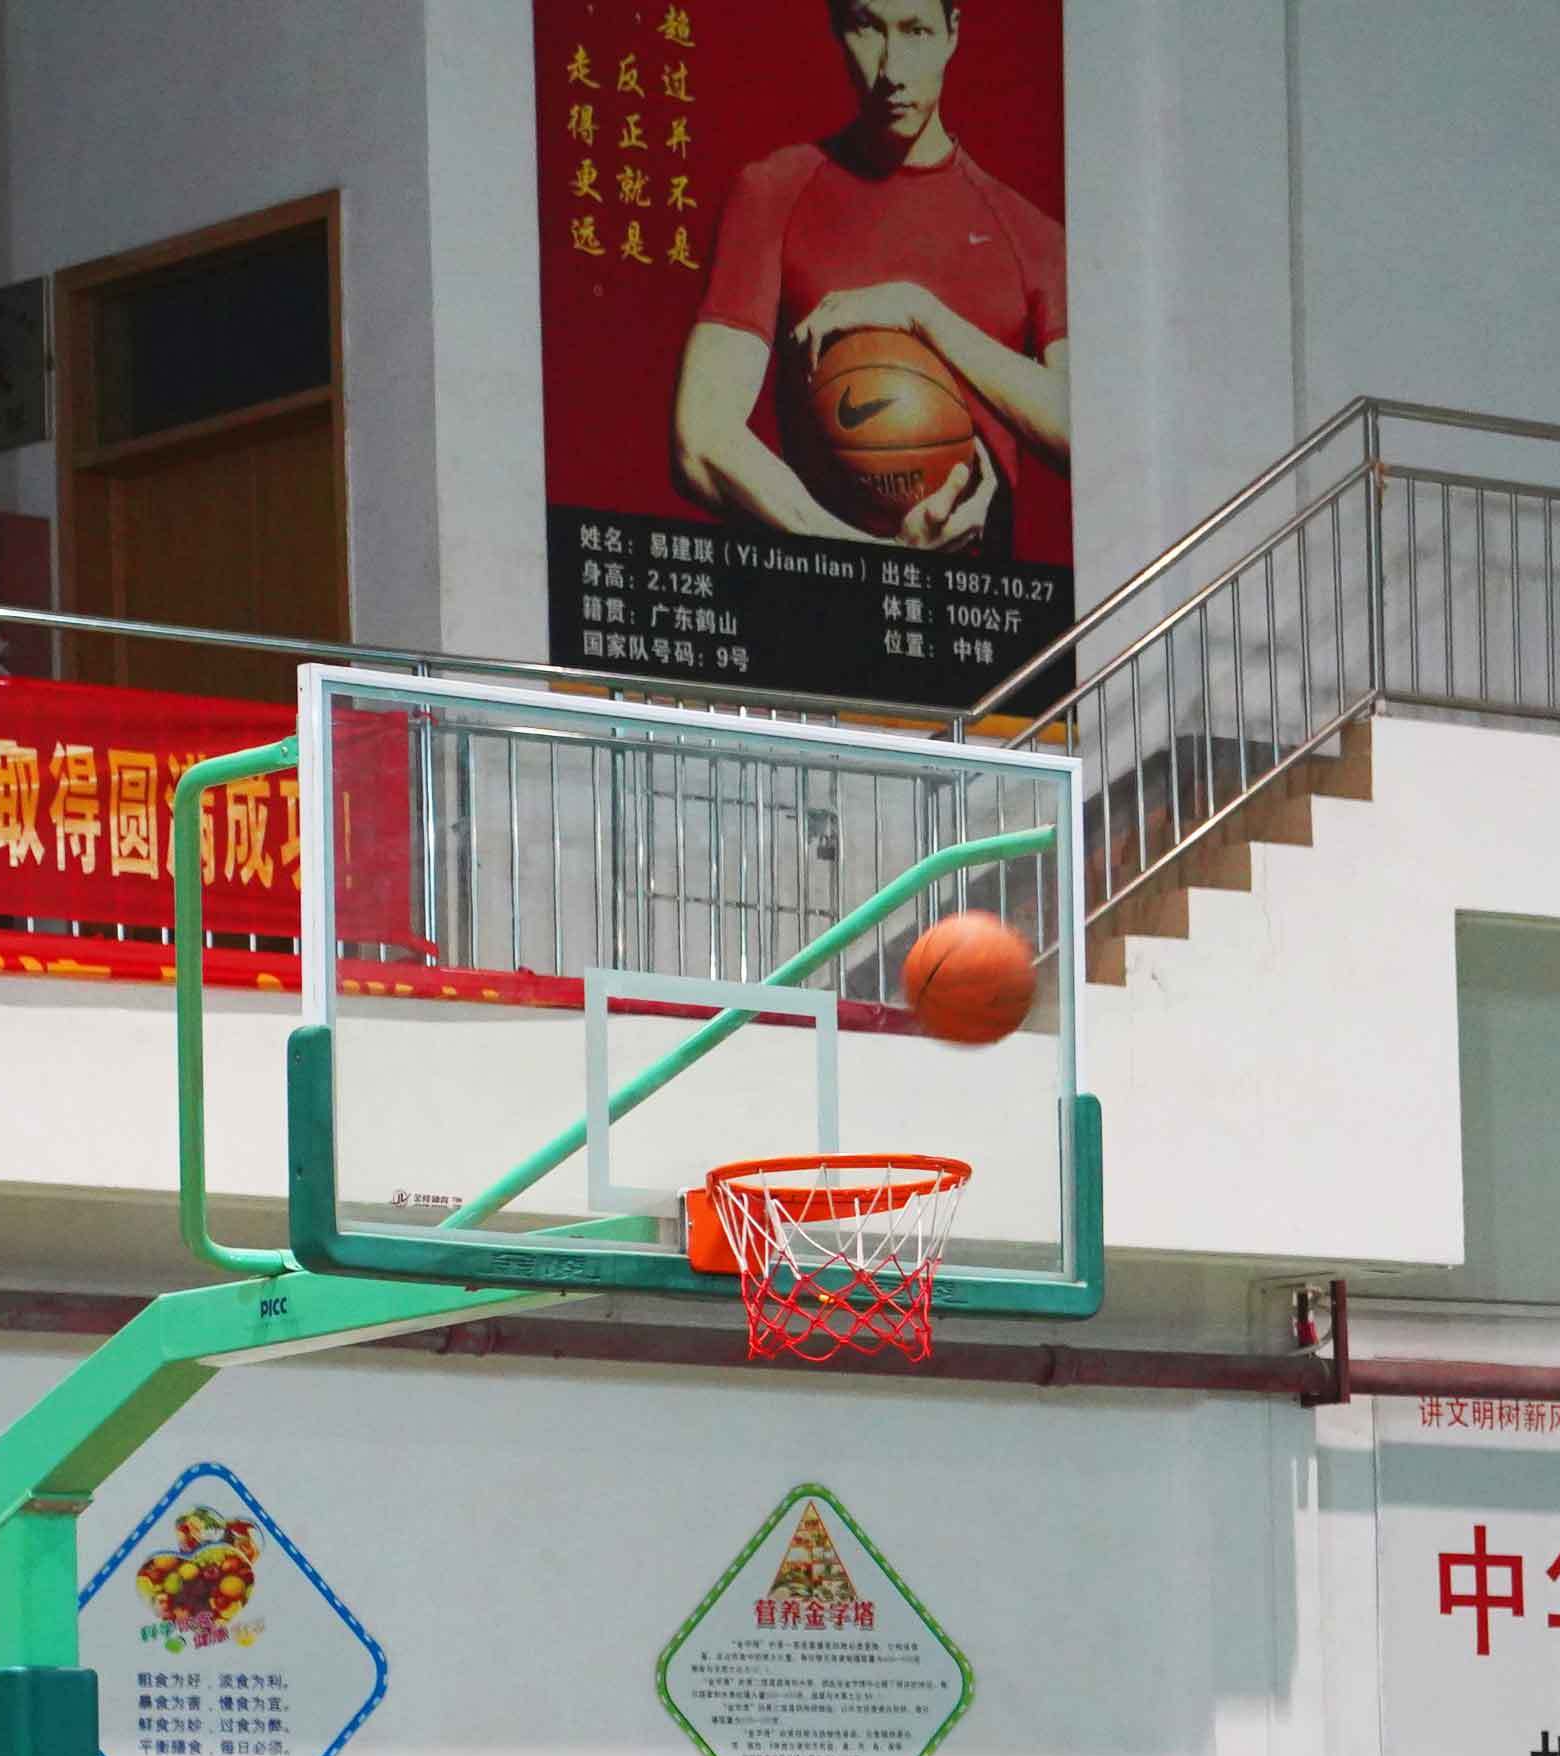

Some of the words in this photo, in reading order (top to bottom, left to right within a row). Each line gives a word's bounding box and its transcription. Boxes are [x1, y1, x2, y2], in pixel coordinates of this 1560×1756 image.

[764, 549, 809, 573] Jian
[756, 1599, 875, 1630] 营养金字塔
